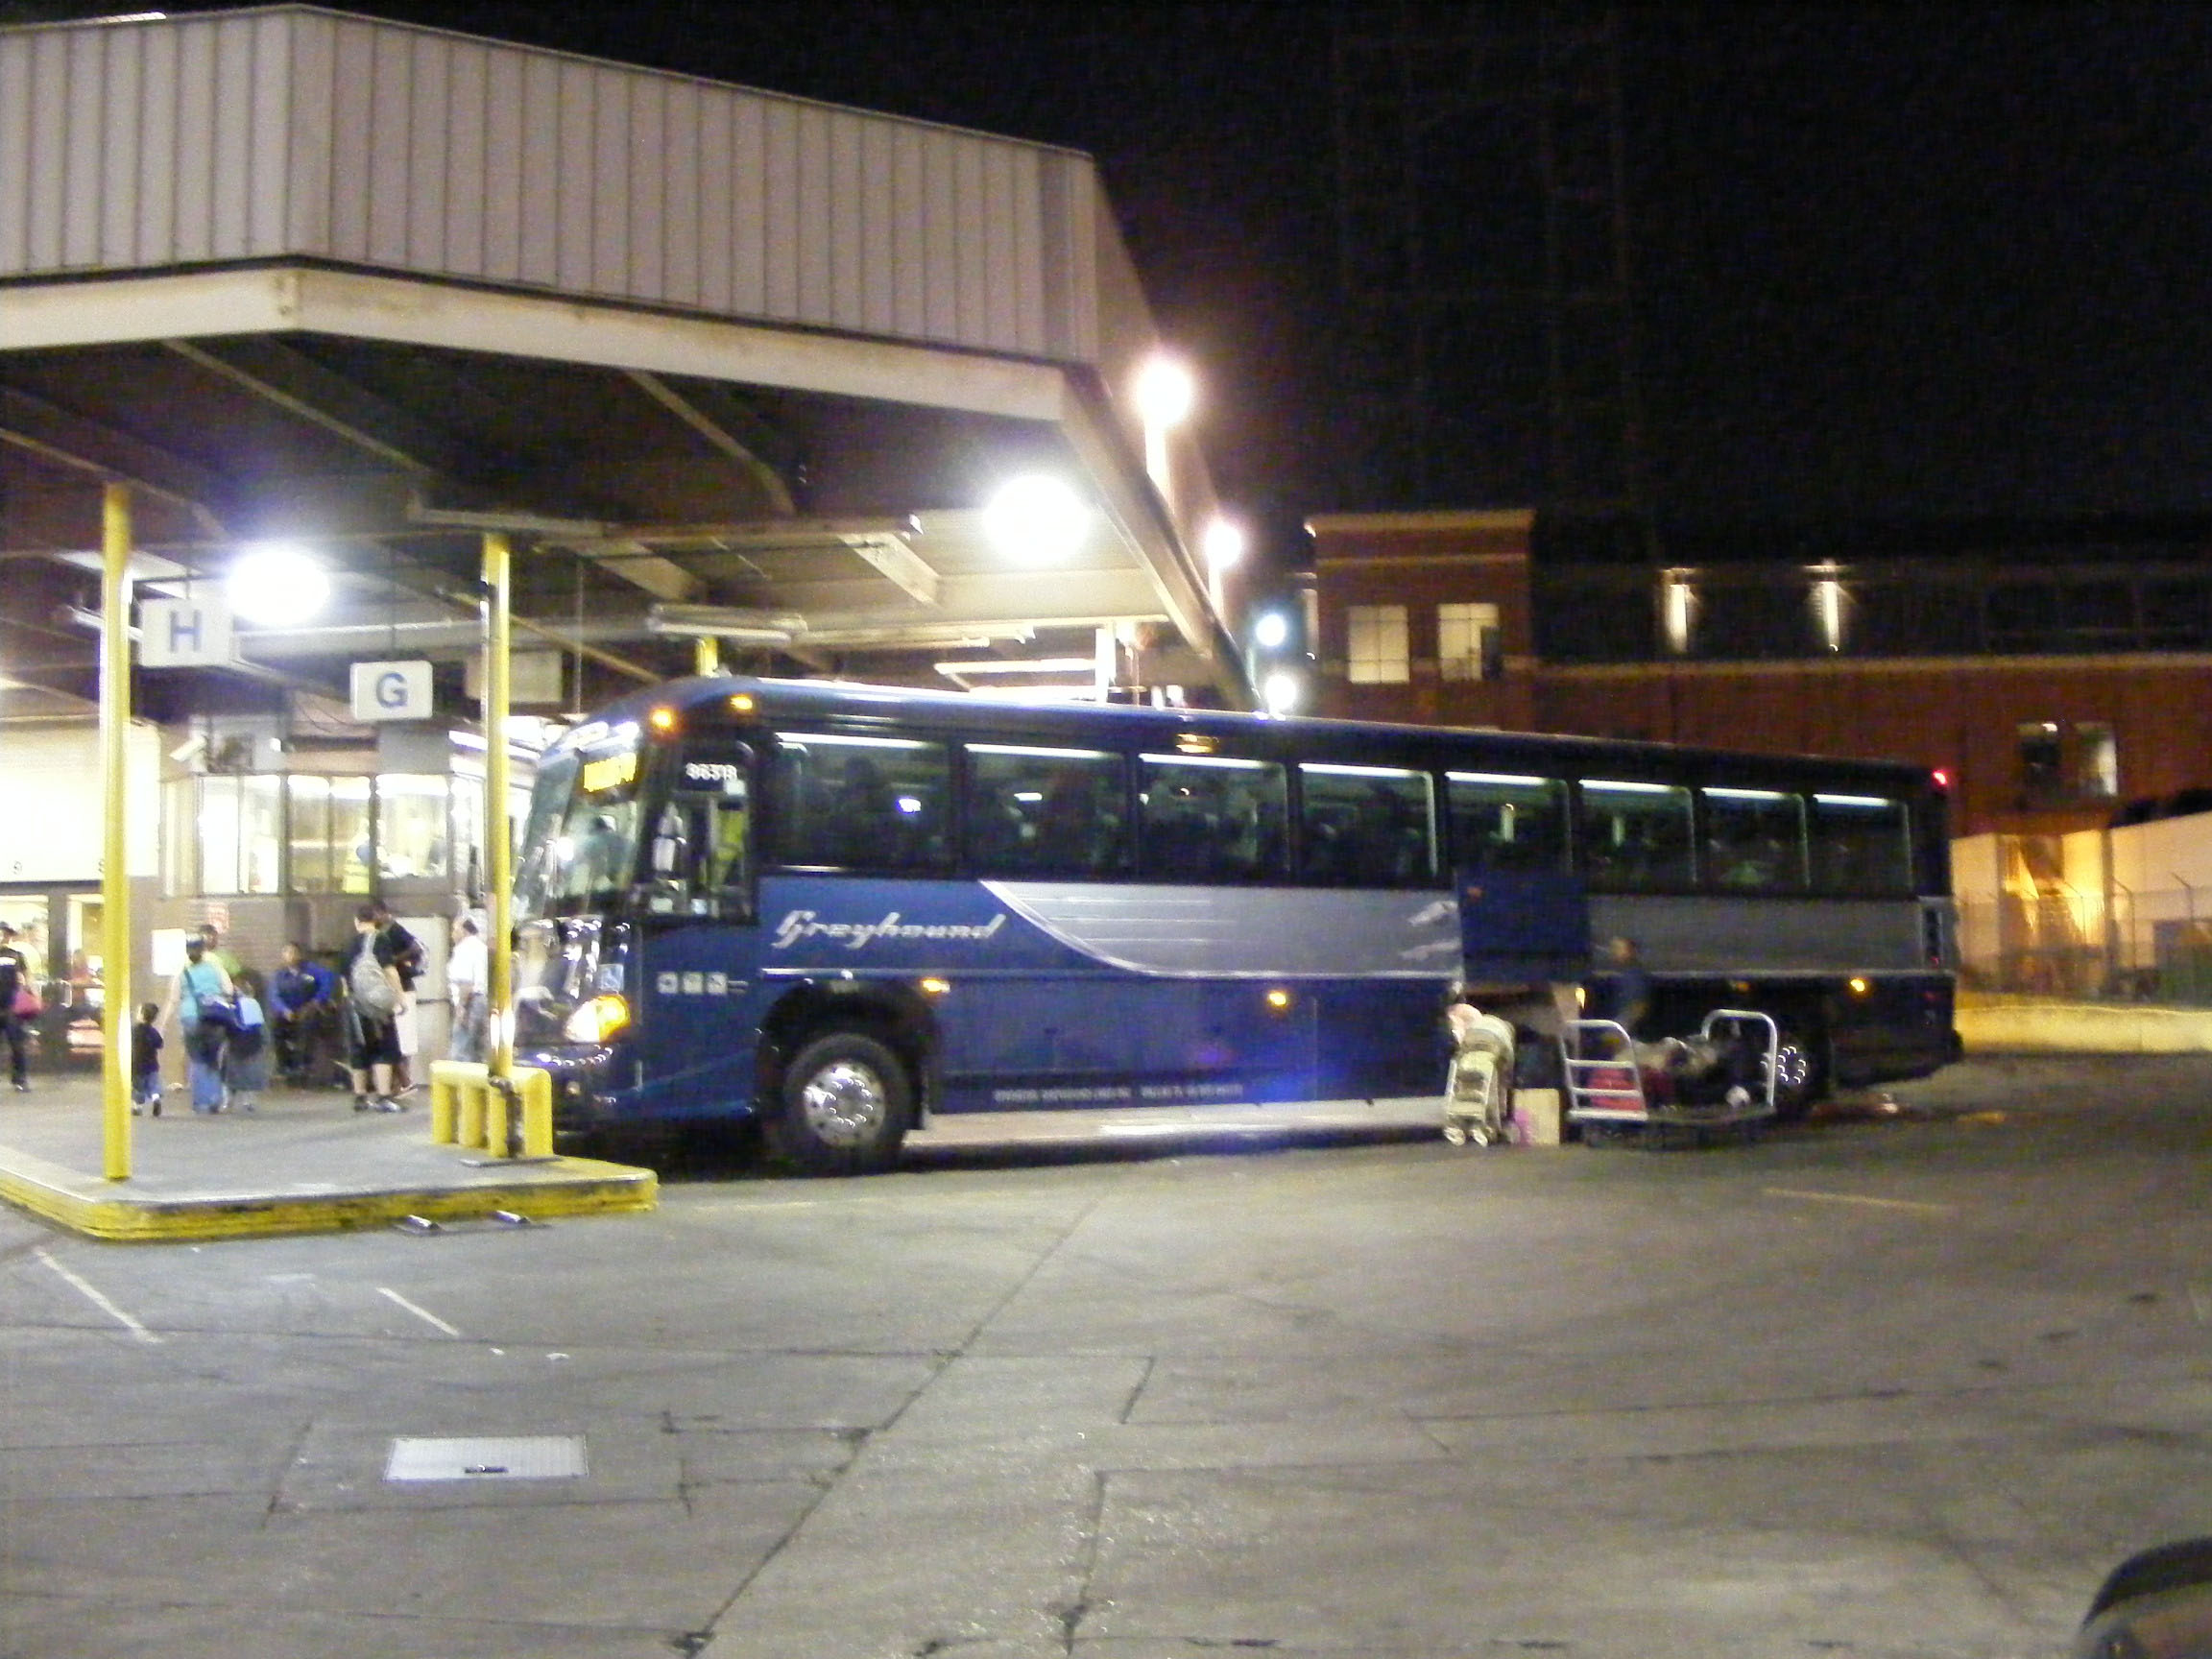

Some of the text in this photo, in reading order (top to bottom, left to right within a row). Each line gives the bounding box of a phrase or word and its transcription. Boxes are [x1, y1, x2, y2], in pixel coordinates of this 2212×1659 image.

[169, 609, 203, 654] H
[375, 671, 409, 709] G
[771, 910, 1006, 950] Greyhound
